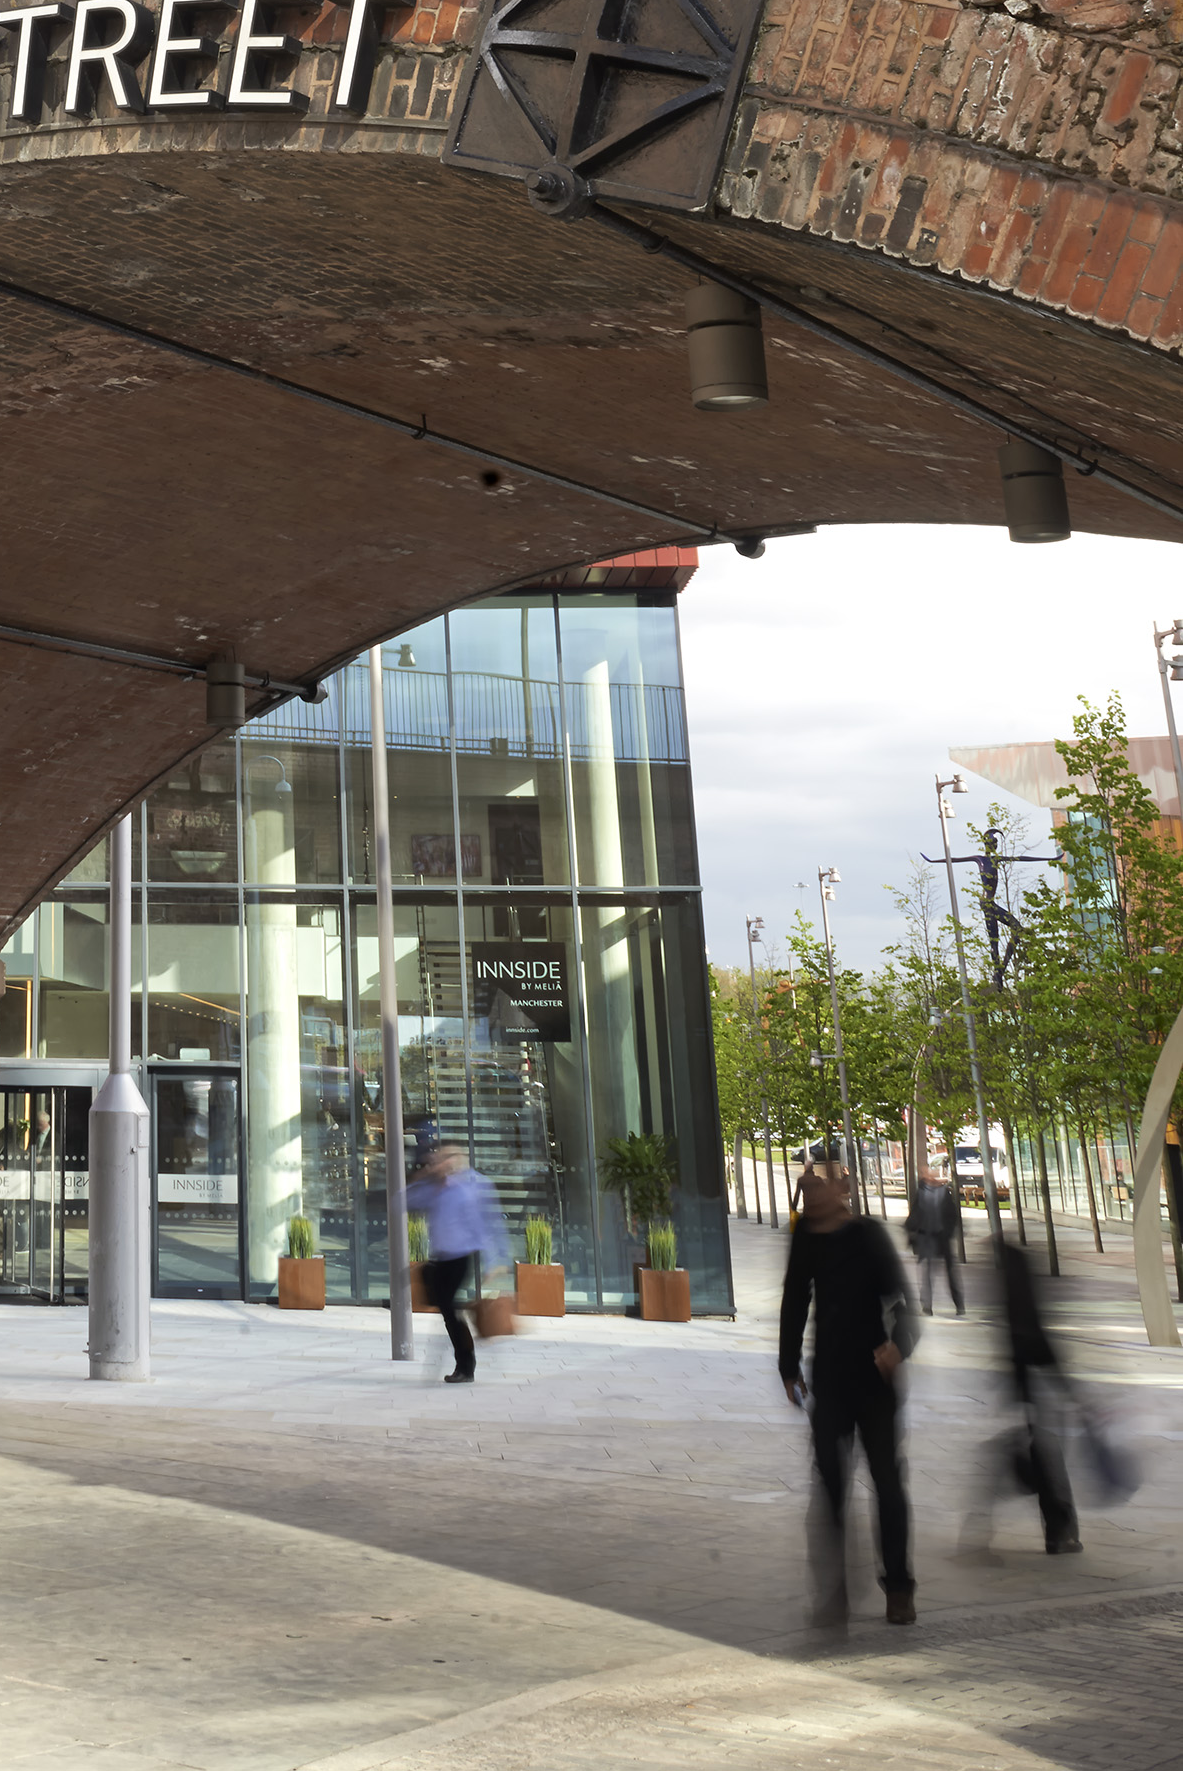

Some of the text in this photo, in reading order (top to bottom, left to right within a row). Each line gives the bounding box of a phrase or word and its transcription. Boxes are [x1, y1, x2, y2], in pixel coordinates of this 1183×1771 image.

[477, 960, 561, 979] INNSIDE
[521, 982, 532, 990] BY
[510, 999, 563, 1007] MANCHESTER
[505, 1026, 540, 1034] innside.com
[172, 1179, 223, 1191] INNSIDE
